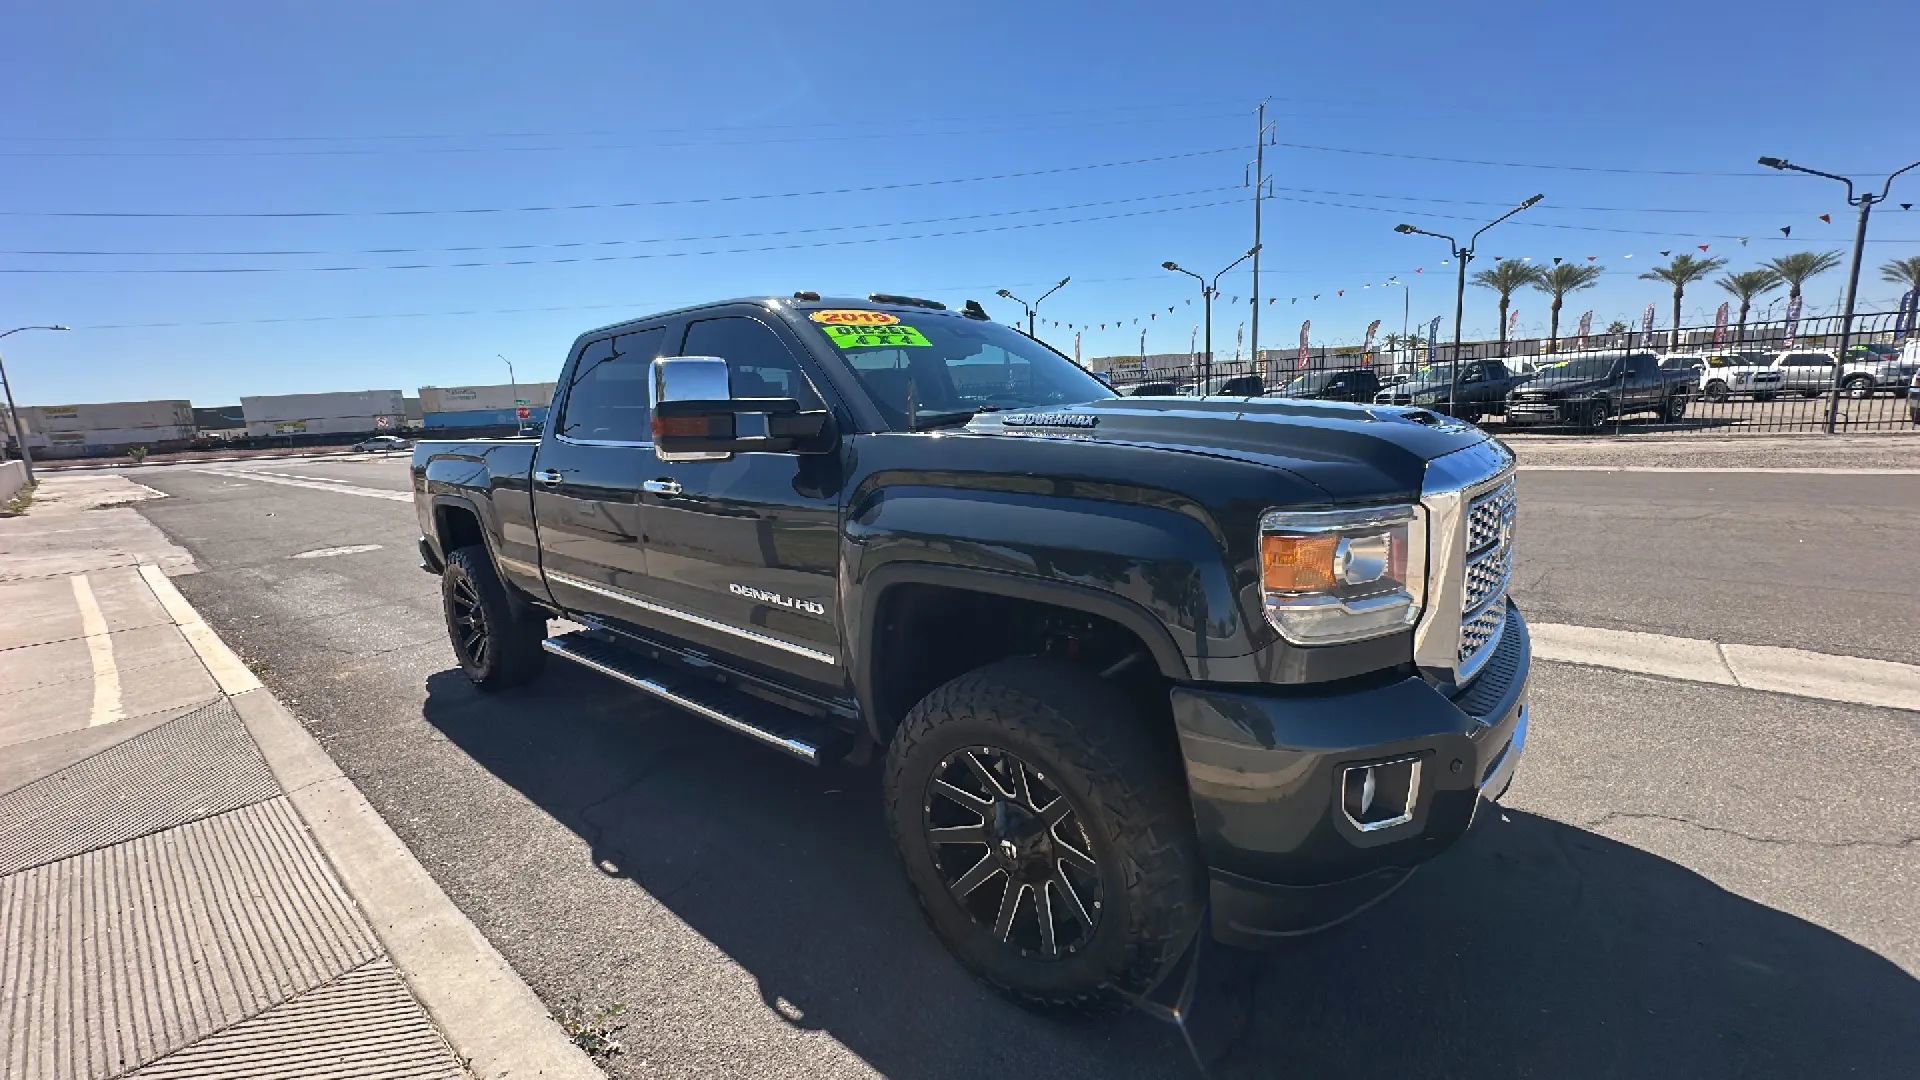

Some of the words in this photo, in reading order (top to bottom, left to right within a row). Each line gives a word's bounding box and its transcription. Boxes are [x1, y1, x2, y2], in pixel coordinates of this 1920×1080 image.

[836, 326, 917, 336] DIESEL
[1024, 414, 1099, 427] DURAMAX
[730, 583, 793, 607] DENALI
[795, 599, 824, 615] HD
